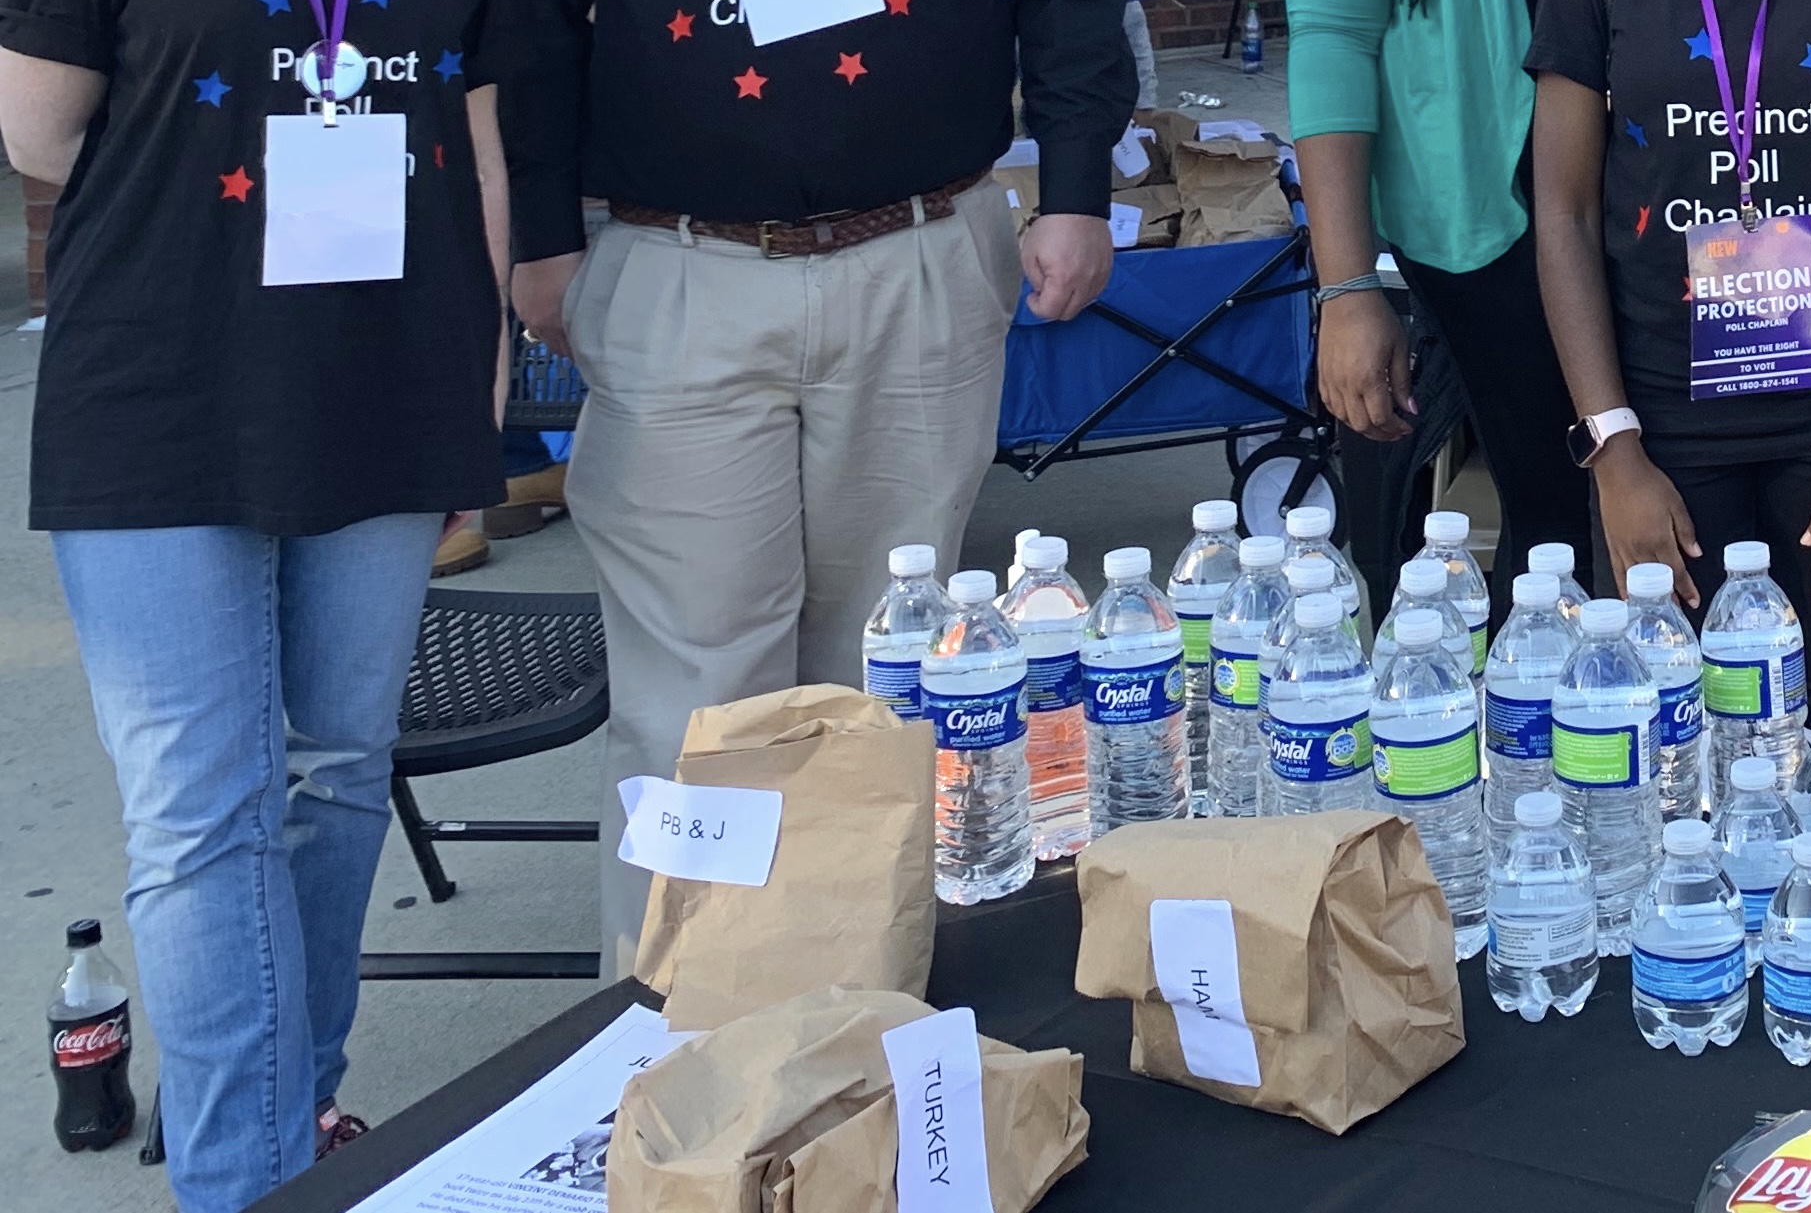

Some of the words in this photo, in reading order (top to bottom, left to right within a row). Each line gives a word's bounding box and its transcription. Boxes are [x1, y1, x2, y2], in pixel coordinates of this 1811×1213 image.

[272, 47, 420, 83] Prnct
[1707, 240, 1738, 259] NEW
[1695, 266, 1811, 299] ELECTION
[1697, 293, 1811, 321] PROTECTION
[1725, 322, 1746, 332] POLL
[1748, 318, 1788, 330] CHAPLAIN
[1714, 348, 1732, 357] YOU
[1734, 344, 1756, 355] HAVE
[1758, 343, 1773, 353] THE
[1775, 341, 1799, 351] RIGHT
[1740, 363, 1751, 373] TO
[1753, 361, 1776, 372] VOTE
[1716, 383, 1737, 393] CALL
[1739, 377, 1799, 390] 1800-874-1541
[1096, 679, 1153, 709] Crystal
[1117, 701, 1149, 709] SPRINGS
[946, 703, 1008, 735] Crystal
[1098, 709, 1126, 719] purified
[1128, 707, 1152, 717] water
[950, 735, 981, 745] purified
[983, 731, 1006, 742] water
[1270, 731, 1313, 760] Crystal
[660, 811, 681, 836] PB
[688, 819, 704, 839] &
[713, 821, 725, 840] J
[1190, 969, 1221, 1021] HAM
[924, 1061, 950, 1187] TURKEY
[508, 1182, 547, 1194] VINCENT
[549, 1189, 595, 1204] DEMARIO
[594, 1196, 608, 1206] TR
